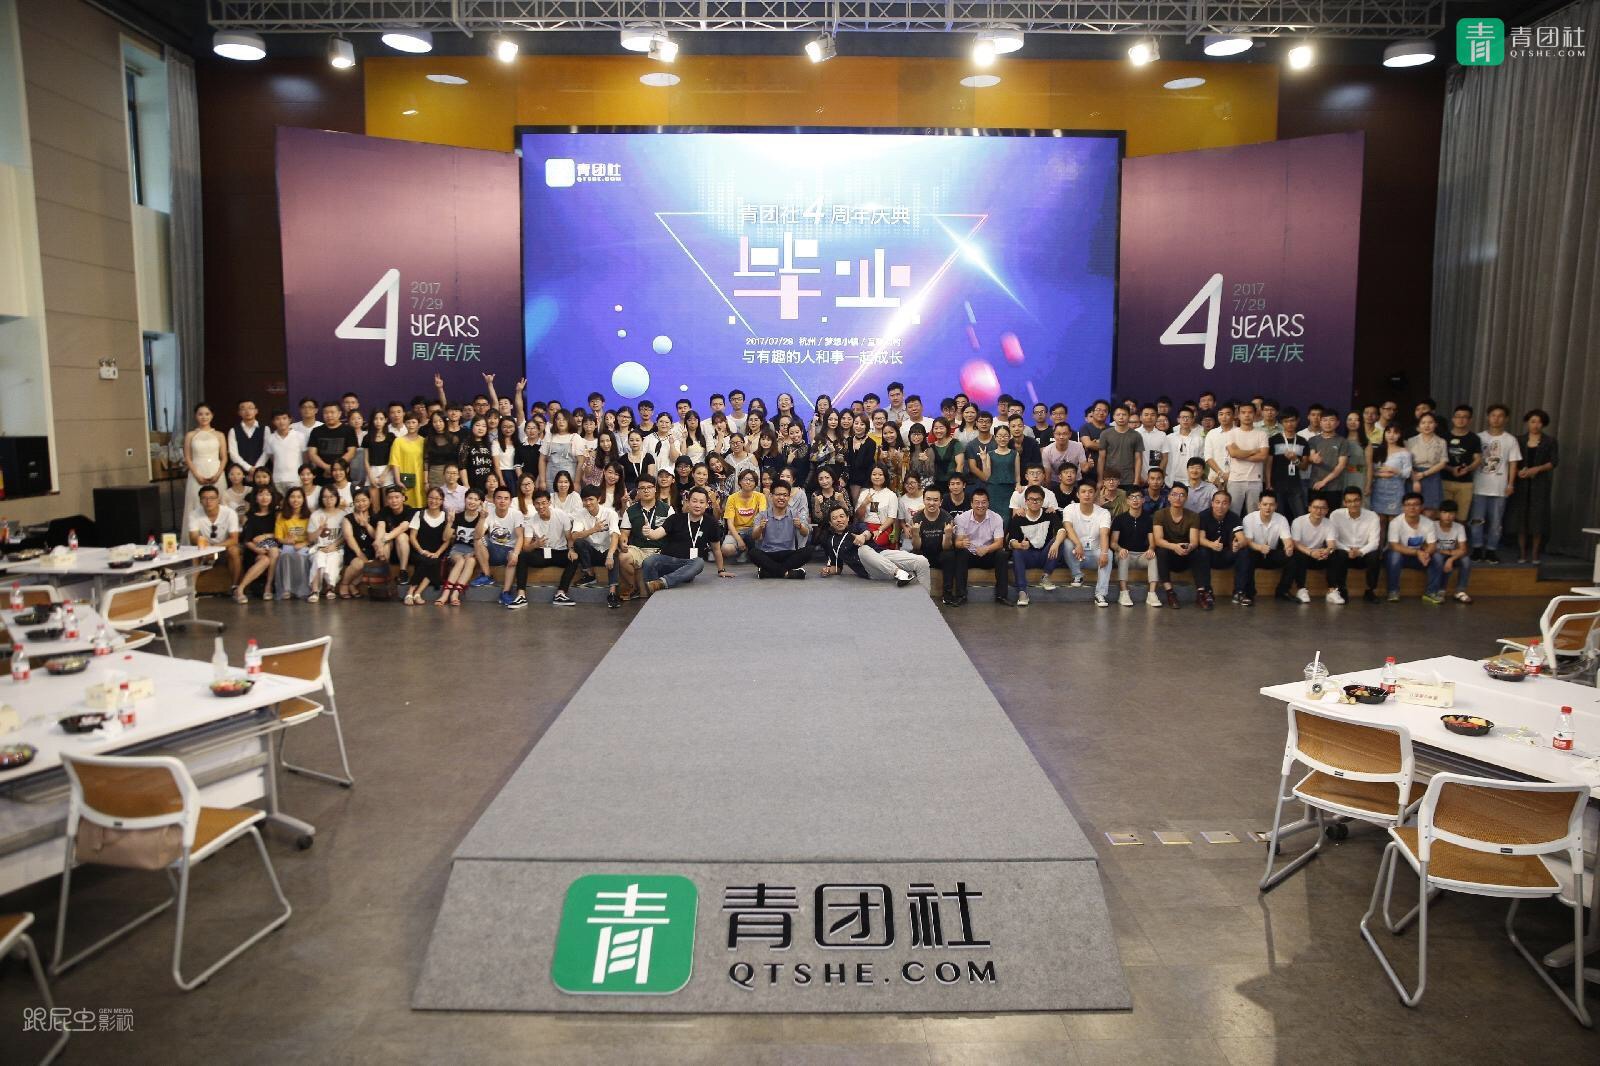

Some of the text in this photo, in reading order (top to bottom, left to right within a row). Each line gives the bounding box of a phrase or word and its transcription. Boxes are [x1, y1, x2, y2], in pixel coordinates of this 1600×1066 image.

[733, 231, 911, 320] 毕业
[410, 281, 441, 294] 2017
[1233, 282, 1265, 296] 2017
[410, 296, 443, 310] 7/29
[1232, 298, 1266, 312] 7/29
[334, 268, 400, 367] 4
[410, 313, 480, 338] YEARS
[1159, 272, 1224, 370] 4
[1231, 313, 1305, 339] YEARS
[411, 342, 481, 362] 周/年/庆
[741, 349, 904, 365] 与有趣的人和事一起成长
[1230, 343, 1305, 363] 周/年/庆
[722, 882, 992, 951] 青团社
[728, 961, 997, 991] QTSHE.COM
